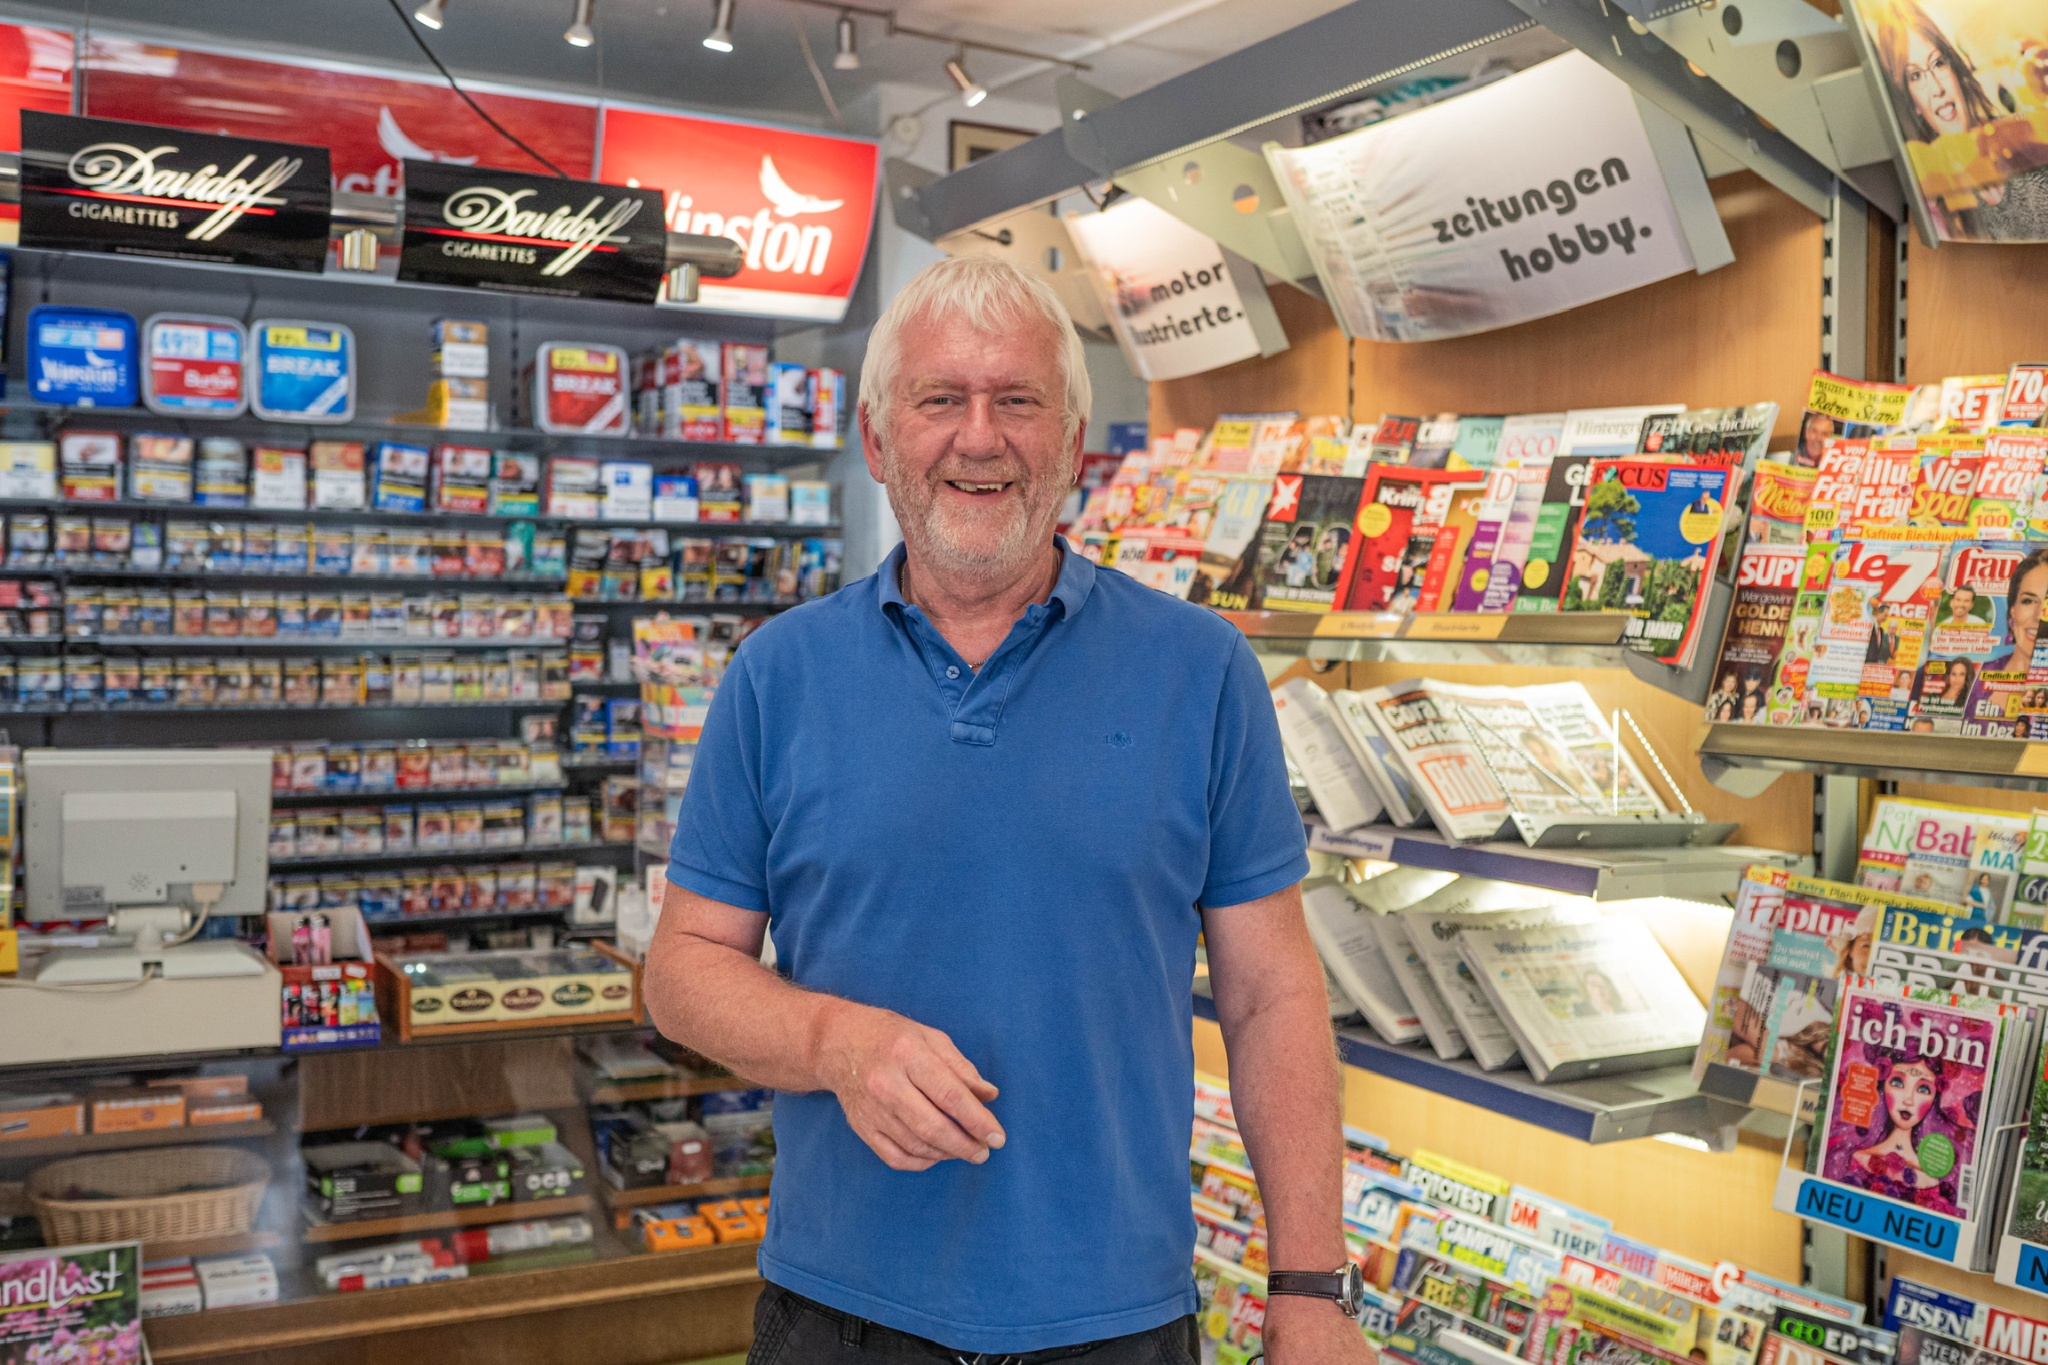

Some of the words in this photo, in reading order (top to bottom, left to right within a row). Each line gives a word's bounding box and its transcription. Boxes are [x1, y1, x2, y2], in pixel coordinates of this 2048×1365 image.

[67, 142, 302, 242] Davidoff
[1431, 156, 1631, 244] zeitungen
[68, 202, 179, 229] CIGARETTES
[442, 187, 643, 276] Davidoff
[442, 240, 537, 265] CIGARETTES
[1500, 214, 1653, 282] hobby.
[266, 354, 340, 377] BREAK
[552, 374, 617, 395] BREAK
[1650, 418, 1683, 436] ZEIT
[1845, 445, 1866, 455] von
[1984, 439, 2048, 459] Neues
[1863, 451, 1908, 485] illu
[2022, 460, 2040, 472] die
[1594, 467, 1666, 489] FCUS
[1977, 461, 2040, 495] Frau
[1855, 486, 1914, 519] Frau
[1909, 483, 1972, 522] Spa
[1809, 510, 1834, 520] 100
[1976, 515, 2008, 529] 100
[1865, 529, 1903, 542] Saftige
[1906, 529, 1975, 542] Blechkuchen
[1955, 547, 2020, 588] frau
[1210, 590, 1249, 611] SUN
[1878, 601, 1929, 620] AGE
[1644, 619, 1684, 641] IMMER
[1949, 636, 1981, 645] Wahrheit
[1981, 638, 1999, 646] über
[1982, 672, 2011, 680] Endlich
[1975, 699, 2000, 717] Ein
[1960, 721, 1982, 737] im
[1986, 721, 2015, 738] Dez
[1796, 882, 1826, 896] Extra
[1828, 887, 1853, 900] Plan
[1854, 889, 1870, 903] für
[1775, 943, 1789, 954] Du
[1790, 946, 1820, 959] siehst
[1773, 955, 1789, 966] toll
[1791, 958, 1811, 970] aus!
[1849, 1004, 1907, 1052] ich
[1919, 1017, 1985, 1068] bin
[525, 1172, 571, 1190] OCB
[1408, 1162, 1496, 1217] FOTOTEST
[1806, 1186, 1864, 1223] NEU
[1883, 1210, 1945, 1249] NEU
[1617, 1279, 1693, 1323] DVD
[1891, 1295, 1970, 1341] EISEN
[1779, 1317, 1826, 1347] GEO
